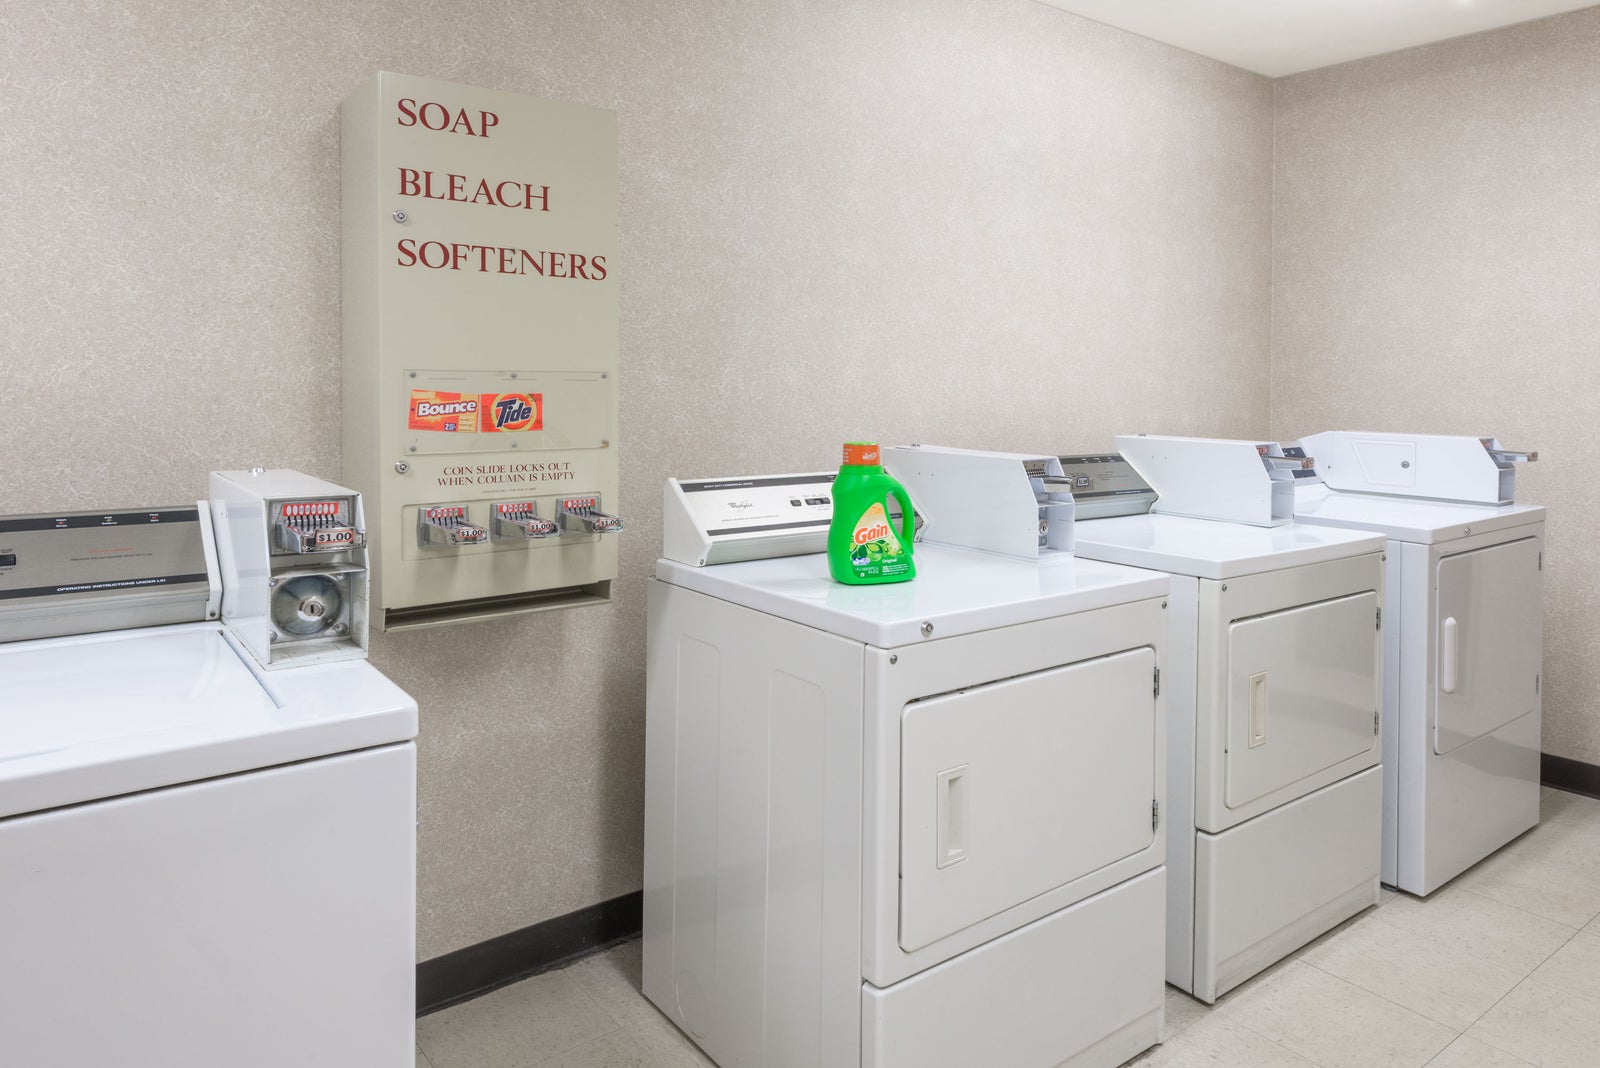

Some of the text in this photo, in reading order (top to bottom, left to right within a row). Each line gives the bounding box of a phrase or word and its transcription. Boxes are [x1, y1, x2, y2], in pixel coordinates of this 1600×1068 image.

[398, 98, 499, 138] SOAP
[398, 167, 550, 212] BLEACH
[397, 238, 607, 281] SOFTENERS
[417, 400, 477, 417] Bounce
[495, 398, 533, 428] Tide
[443, 462, 570, 476] COIN SLIDE LOCKS OUT
[437, 471, 576, 486] WHEN COLUMN IS EMPTY
[530, 523, 551, 531] $1.00
[600, 519, 619, 527] $1.00
[318, 532, 352, 542] $1.00
[461, 529, 483, 537] $1.00
[854, 524, 889, 545] Gain
[92, 580, 135, 589] INSTRUCTIONS
